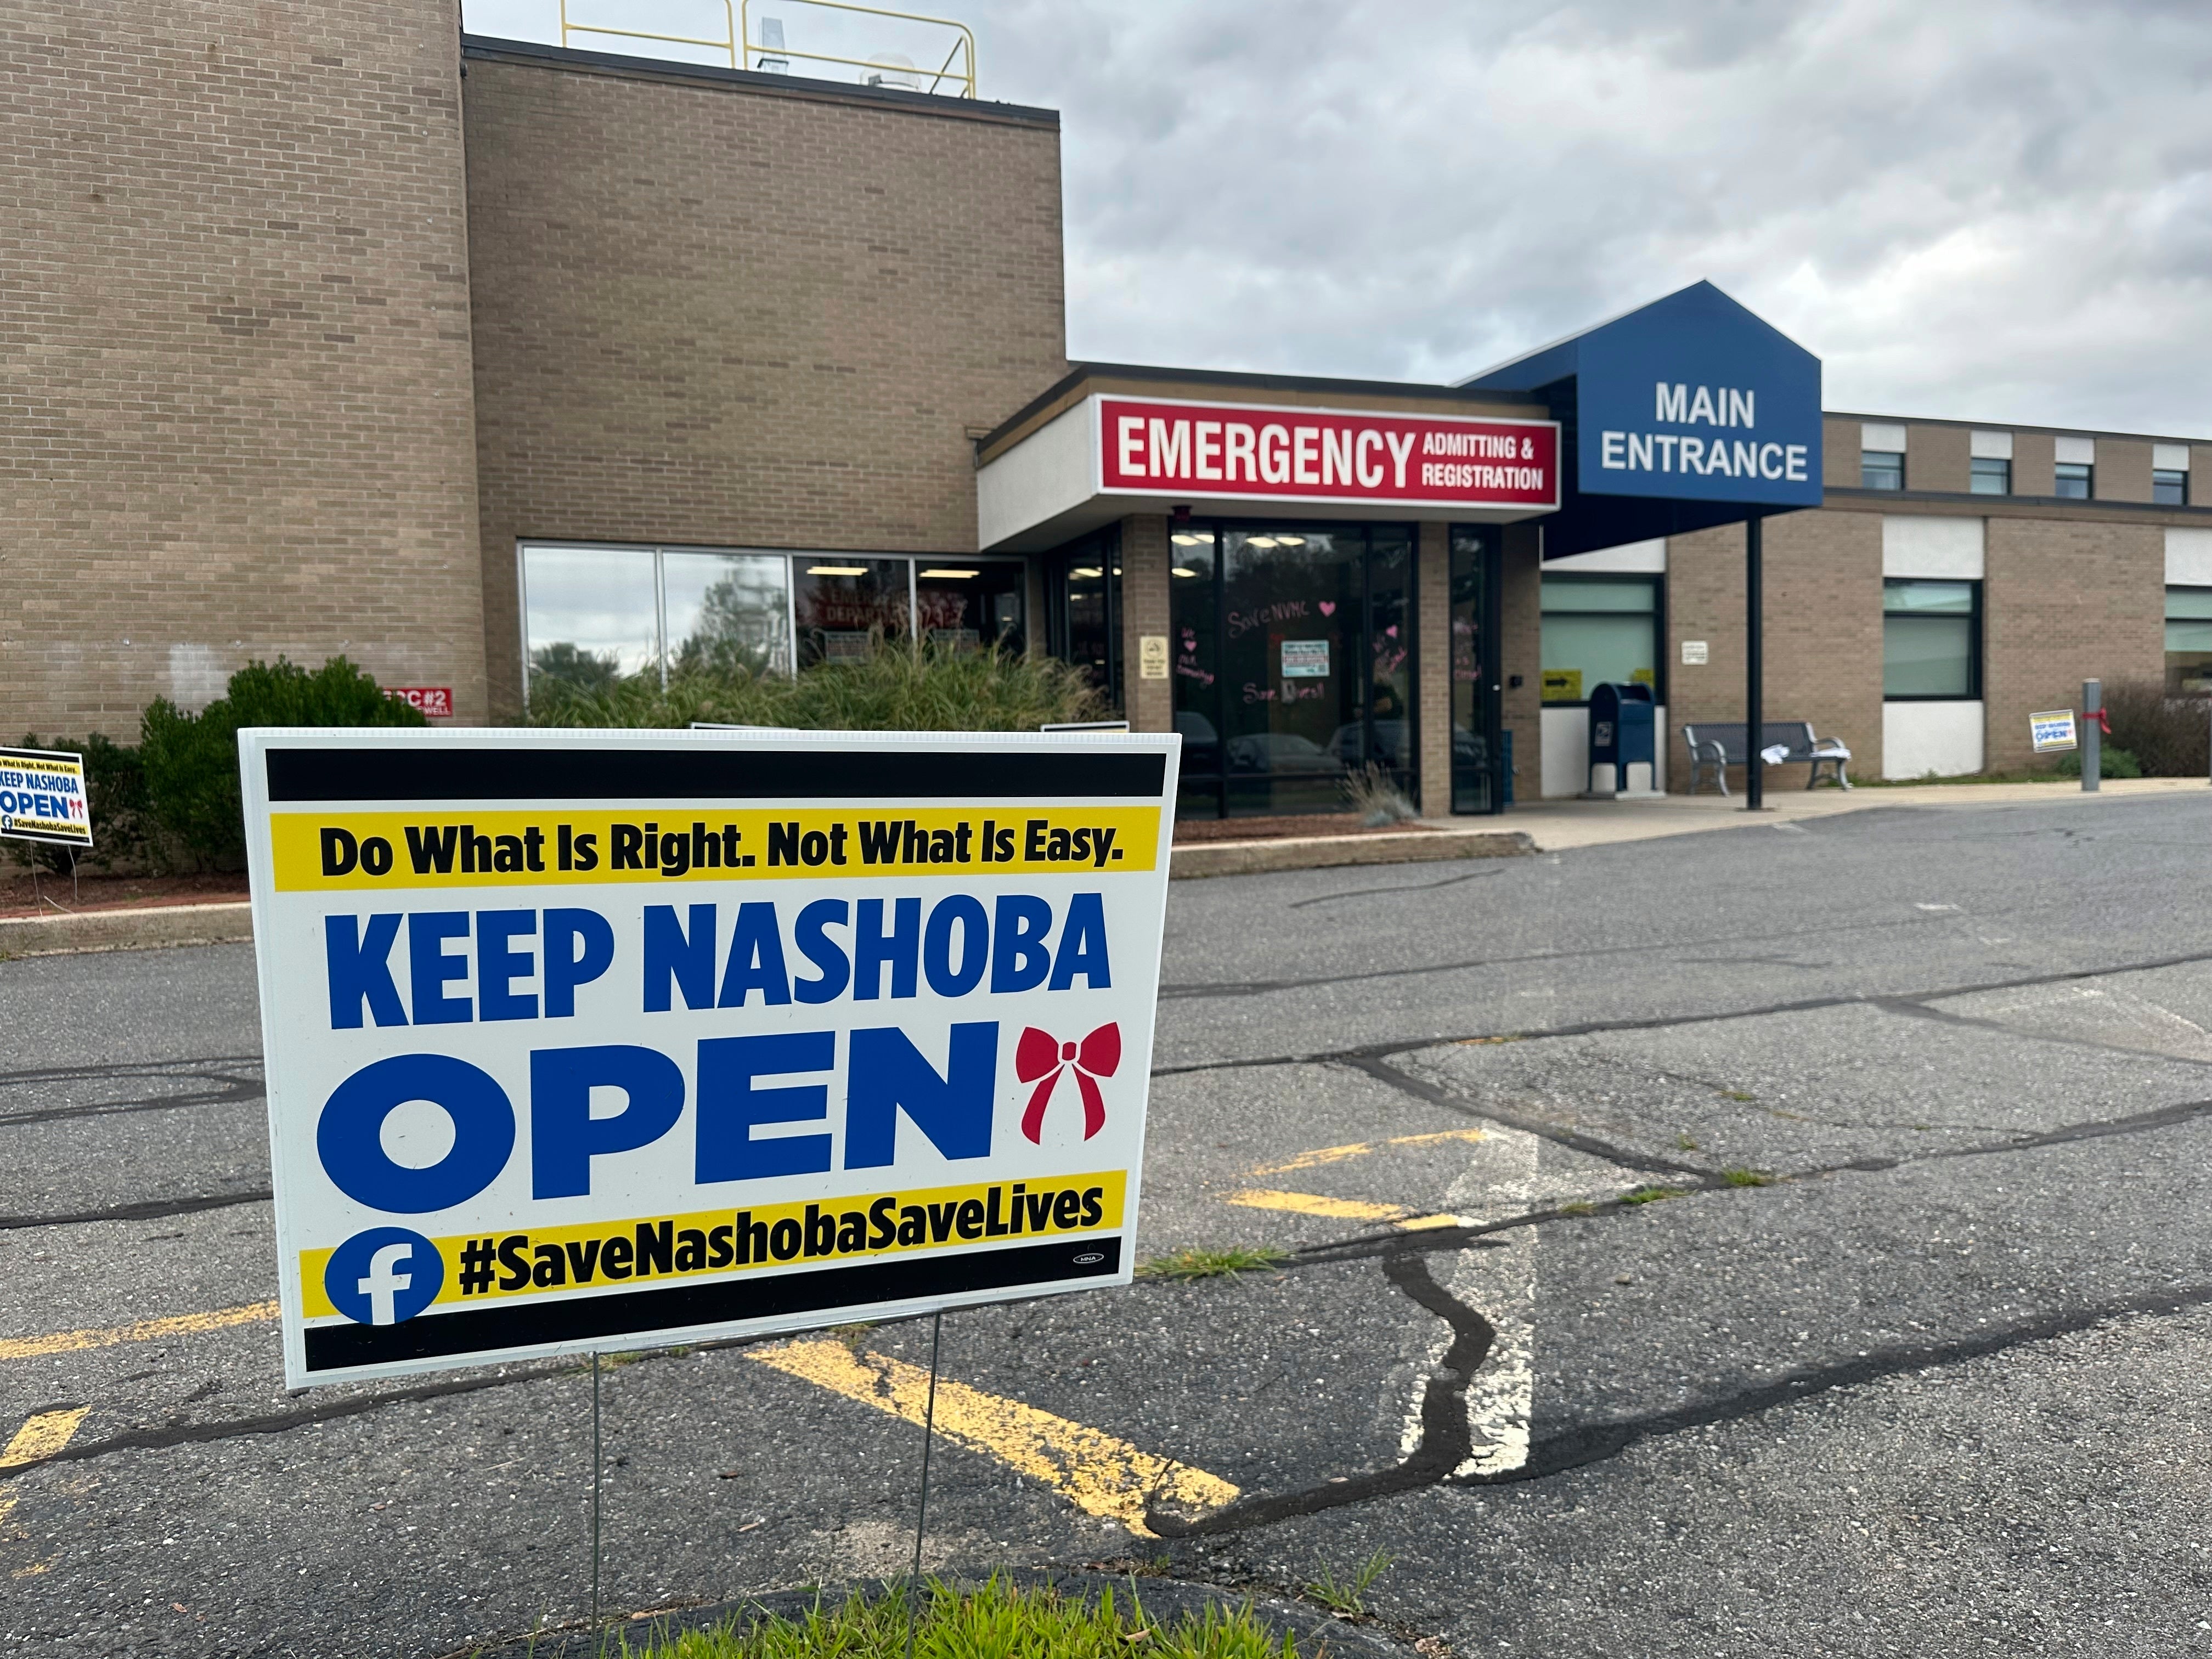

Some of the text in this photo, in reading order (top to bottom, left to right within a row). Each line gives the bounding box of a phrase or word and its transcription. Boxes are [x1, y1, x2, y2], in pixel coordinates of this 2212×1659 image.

[1656, 382, 1754, 429] MAIN
[1118, 415, 1416, 489] EMERGENCY
[1422, 431, 1534, 460] ADMITTING &
[1601, 430, 1808, 482] ENTRANCE
[1421, 465, 1543, 491] REGISTRATION
[2036, 730, 2068, 742] OPEN
[0, 791, 69, 819] OPEN
[26, 772, 78, 794] NASHOBA
[14, 818, 86, 834] #SaveNashobaSaveLives
[320, 820, 1123, 877] Do What Is Right. Not What Is Easy.
[325, 892, 1111, 1030] KEEP NASHOBA
[317, 1020, 1000, 1214] OPEN
[459, 1183, 1103, 1296] #SaveNashobaSaveLives
